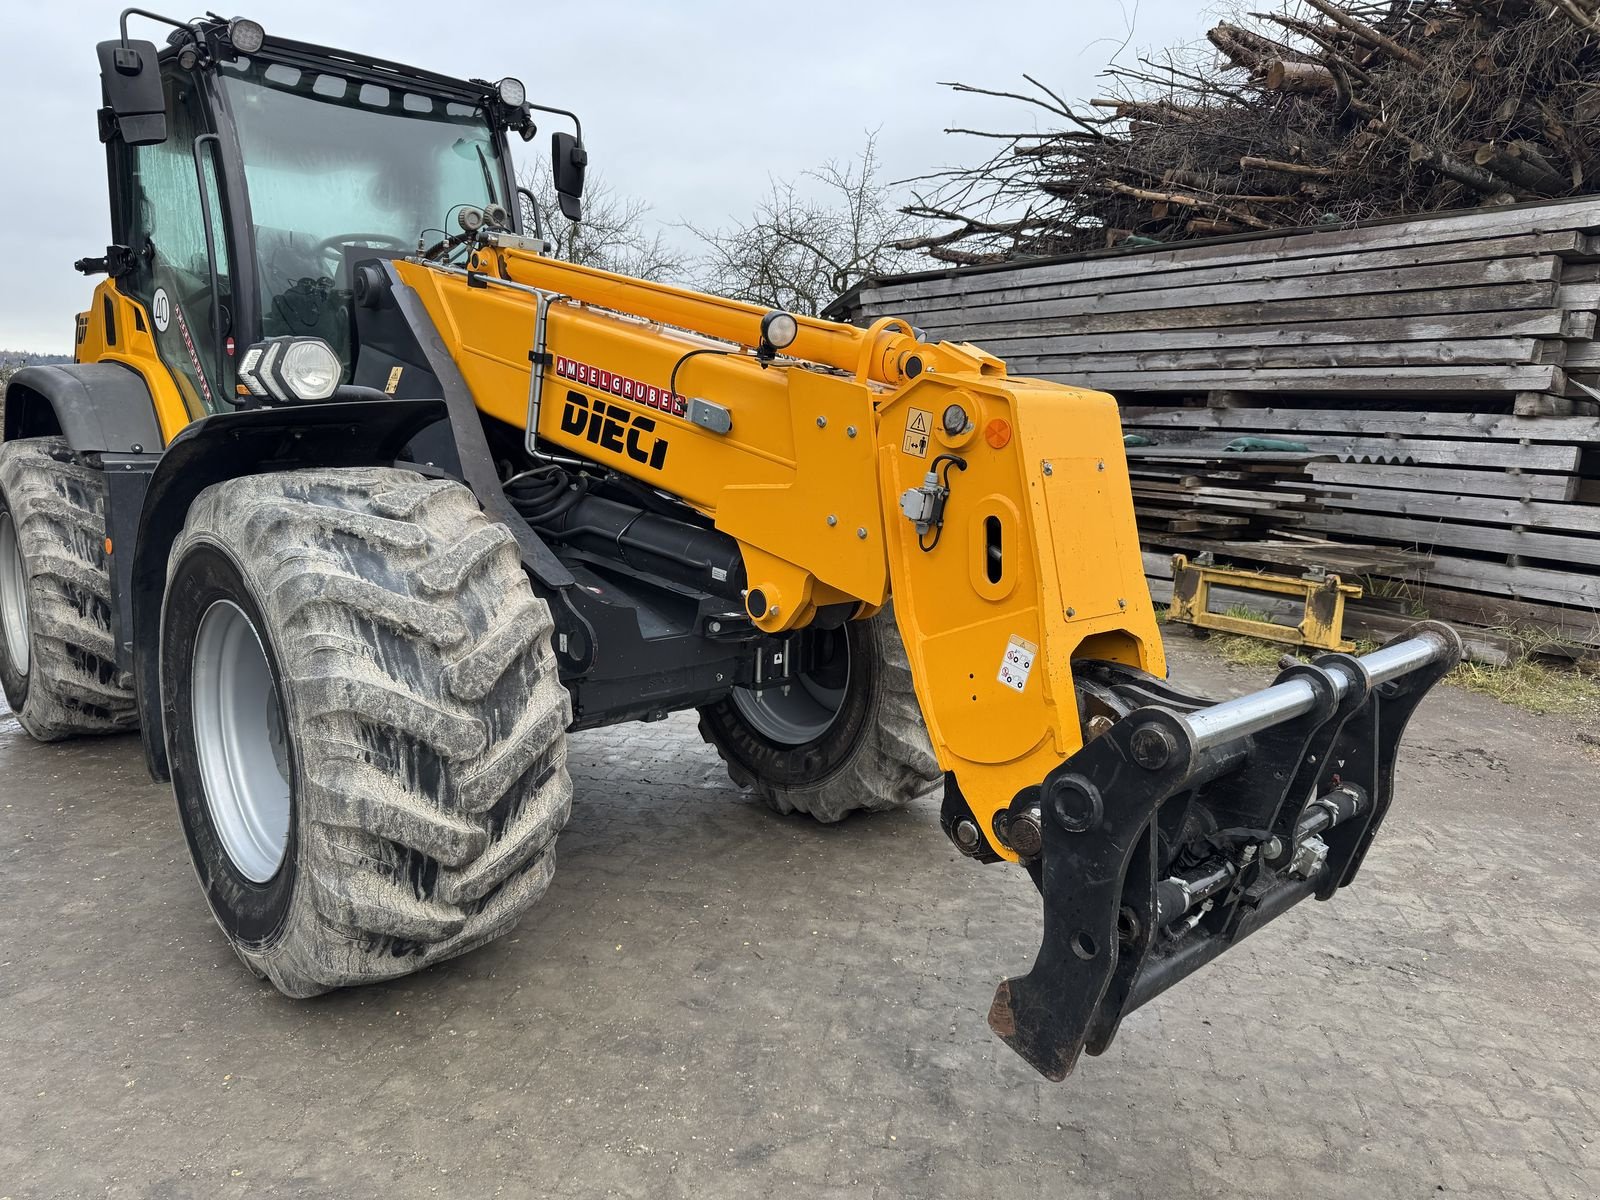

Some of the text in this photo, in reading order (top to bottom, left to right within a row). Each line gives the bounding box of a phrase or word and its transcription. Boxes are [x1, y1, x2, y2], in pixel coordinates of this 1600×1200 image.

[155, 297, 169, 324] 40
[557, 357, 685, 416] AMSELGRUBER
[562, 391, 669, 471] DIECI
